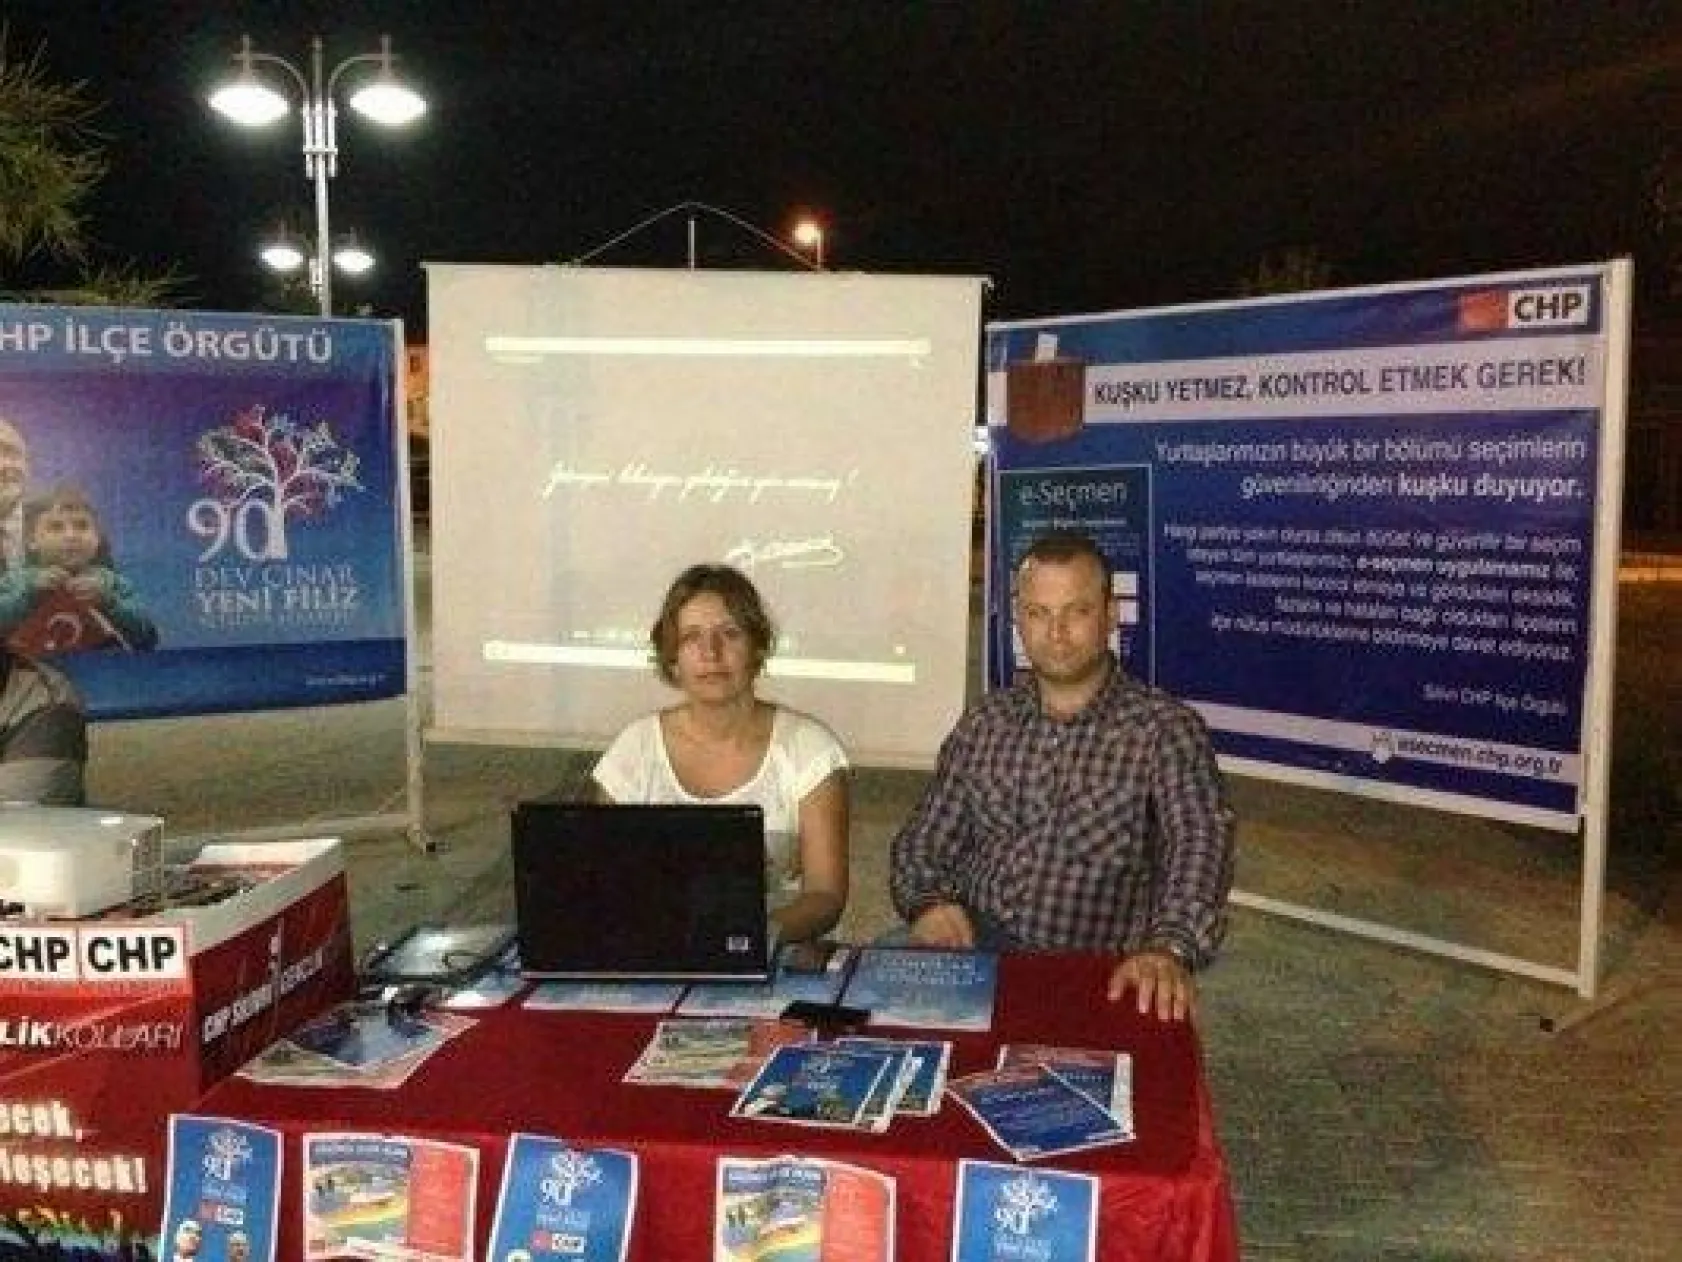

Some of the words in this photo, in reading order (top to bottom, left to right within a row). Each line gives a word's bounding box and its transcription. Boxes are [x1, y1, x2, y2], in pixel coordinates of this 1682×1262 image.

[1515, 292, 1582, 322] CHP
[65, 318, 152, 364] İLÇE
[164, 321, 332, 364] ÖRGÜTÜ
[1095, 378, 1158, 413] KUŞKU
[1167, 375, 1251, 402] YETMEZ,
[1258, 369, 1373, 398] KONTROL
[1379, 362, 1468, 392] ETMEK
[1477, 354, 1585, 389] GEREK!
[1290, 437, 1348, 467] büyük
[1353, 437, 1379, 461] bir
[1384, 436, 1462, 461] bölümü
[1467, 434, 1585, 467] seçimlerin
[1398, 473, 1468, 502] kuşku
[1473, 473, 1582, 502] duyuyor.
[186, 498, 289, 563] 90
[195, 566, 253, 589] DEV
[87, 935, 178, 972] CHP
